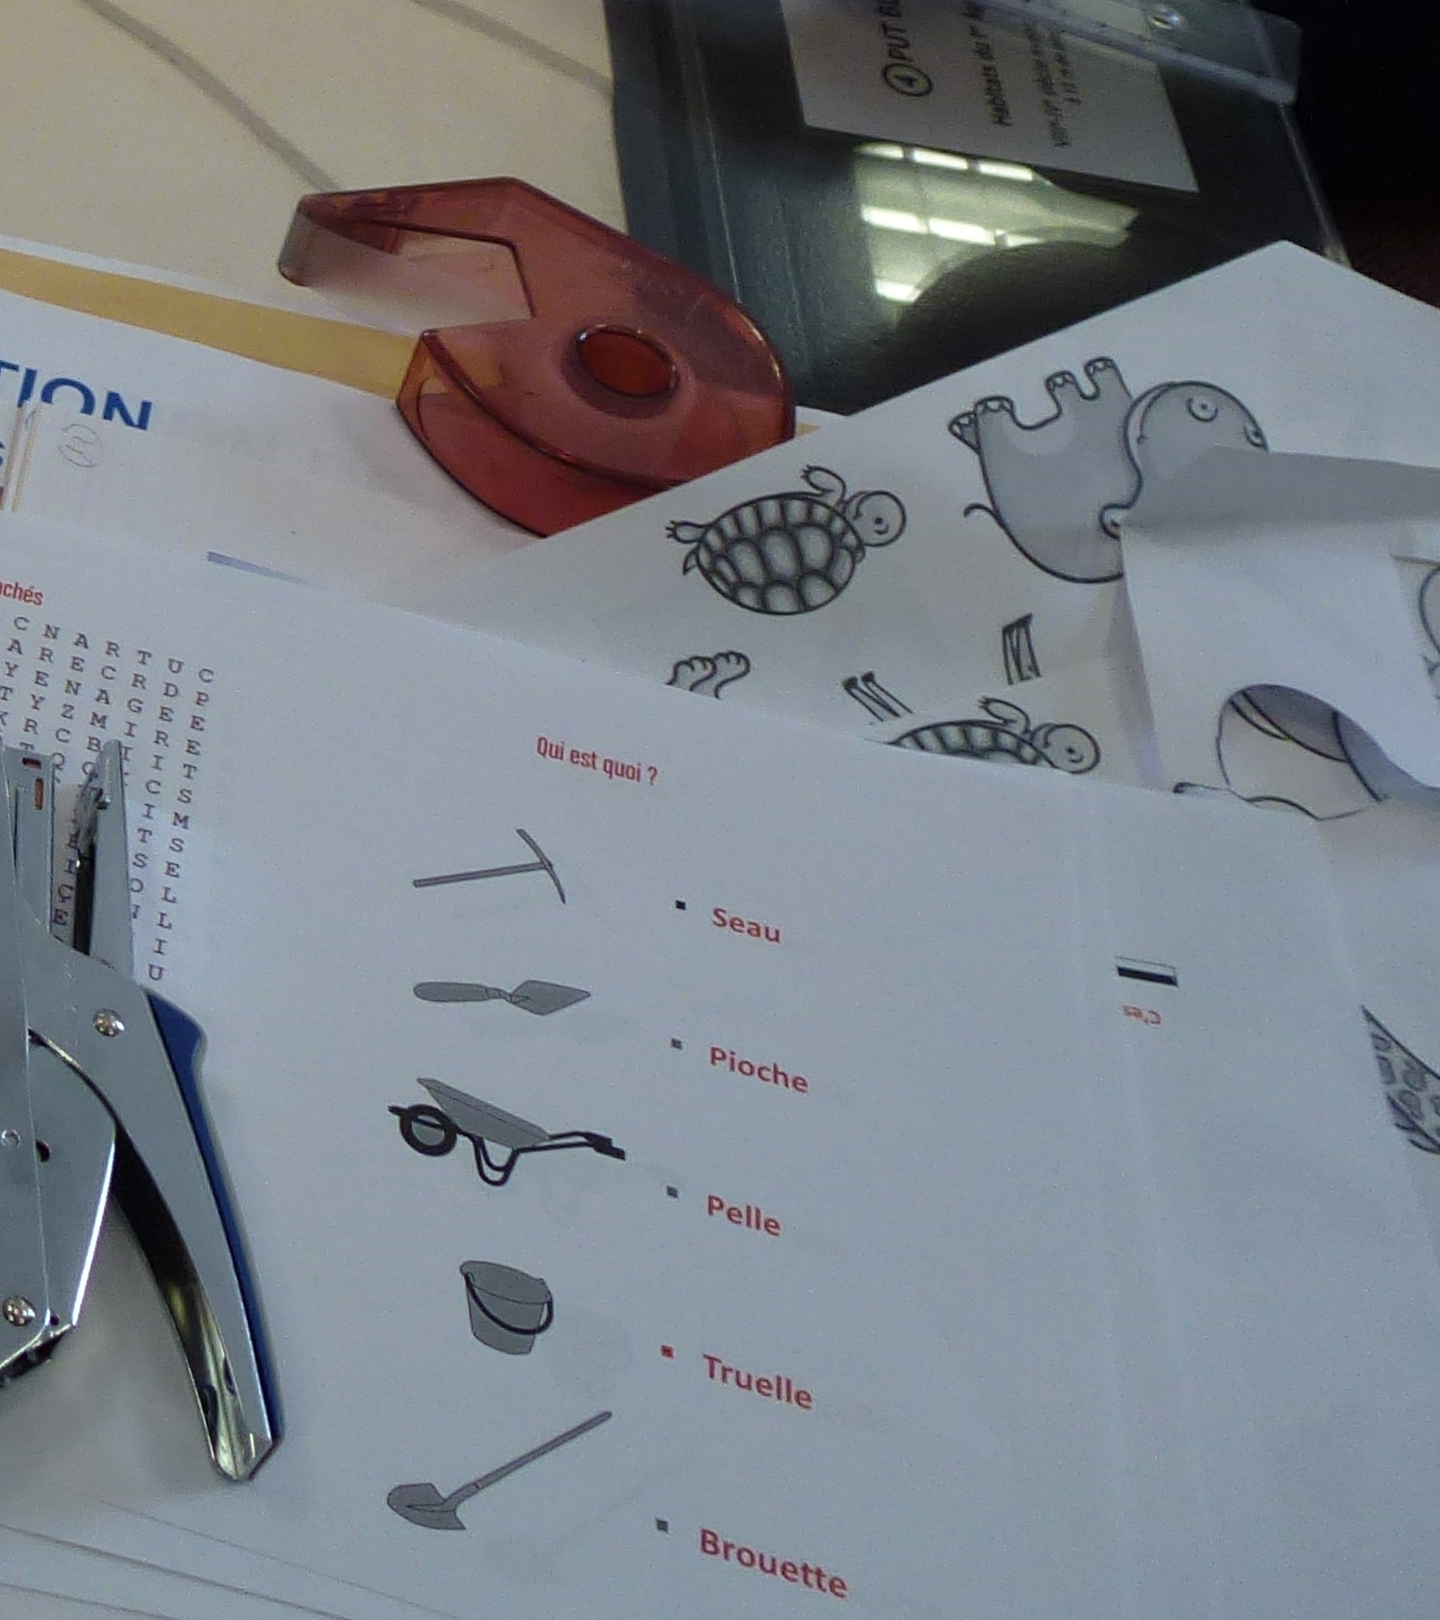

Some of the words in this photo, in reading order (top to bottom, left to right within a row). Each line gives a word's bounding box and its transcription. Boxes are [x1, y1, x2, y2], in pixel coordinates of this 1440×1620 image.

[536, 736, 565, 762] Qui
[570, 747, 598, 770] est
[602, 756, 642, 782] quoi
[712, 907, 782, 944] Seau
[710, 1046, 809, 1094] Pioche
[707, 1194, 782, 1237] Pelle
[703, 1353, 814, 1410] Truelle
[700, 1528, 848, 1600] Brouette
